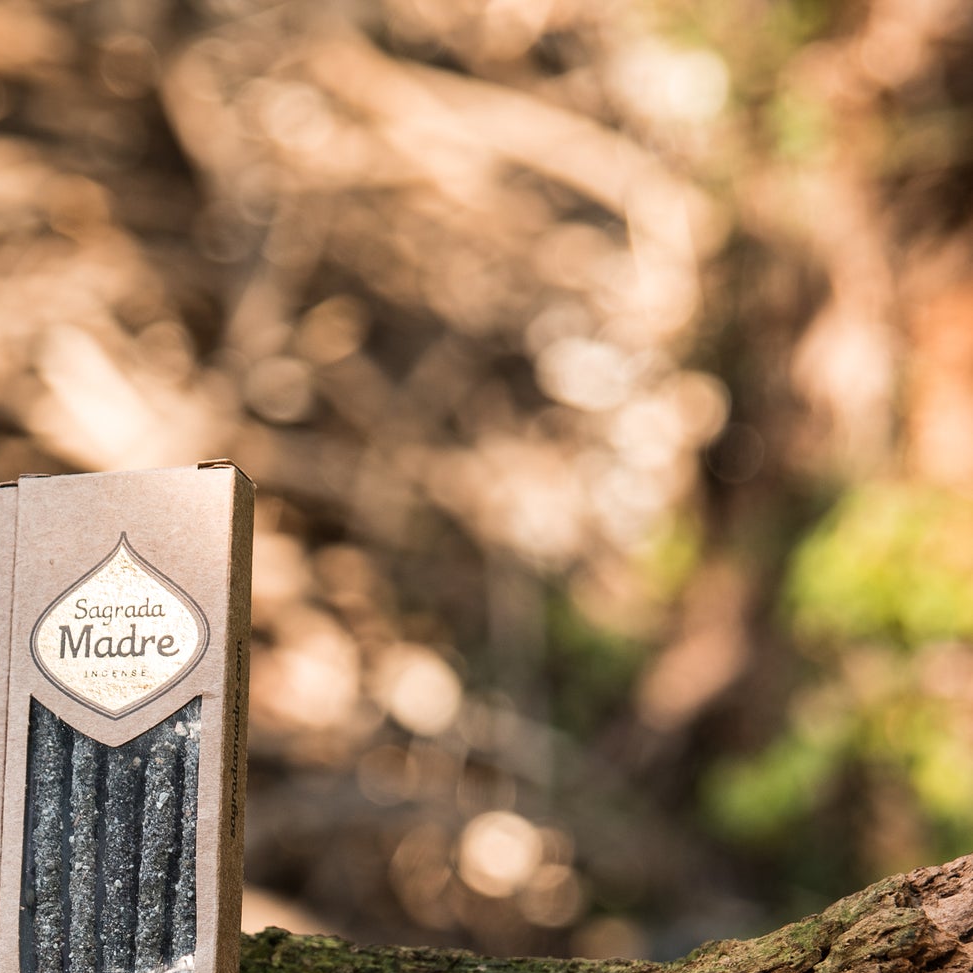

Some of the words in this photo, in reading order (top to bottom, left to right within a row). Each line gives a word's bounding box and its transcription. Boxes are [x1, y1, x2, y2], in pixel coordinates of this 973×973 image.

[74, 597, 165, 626] Sagrada
[59, 623, 180, 659] Madre
[84, 669, 147, 678] INCENSE
[230, 640, 242, 839] sagradamadre.com
